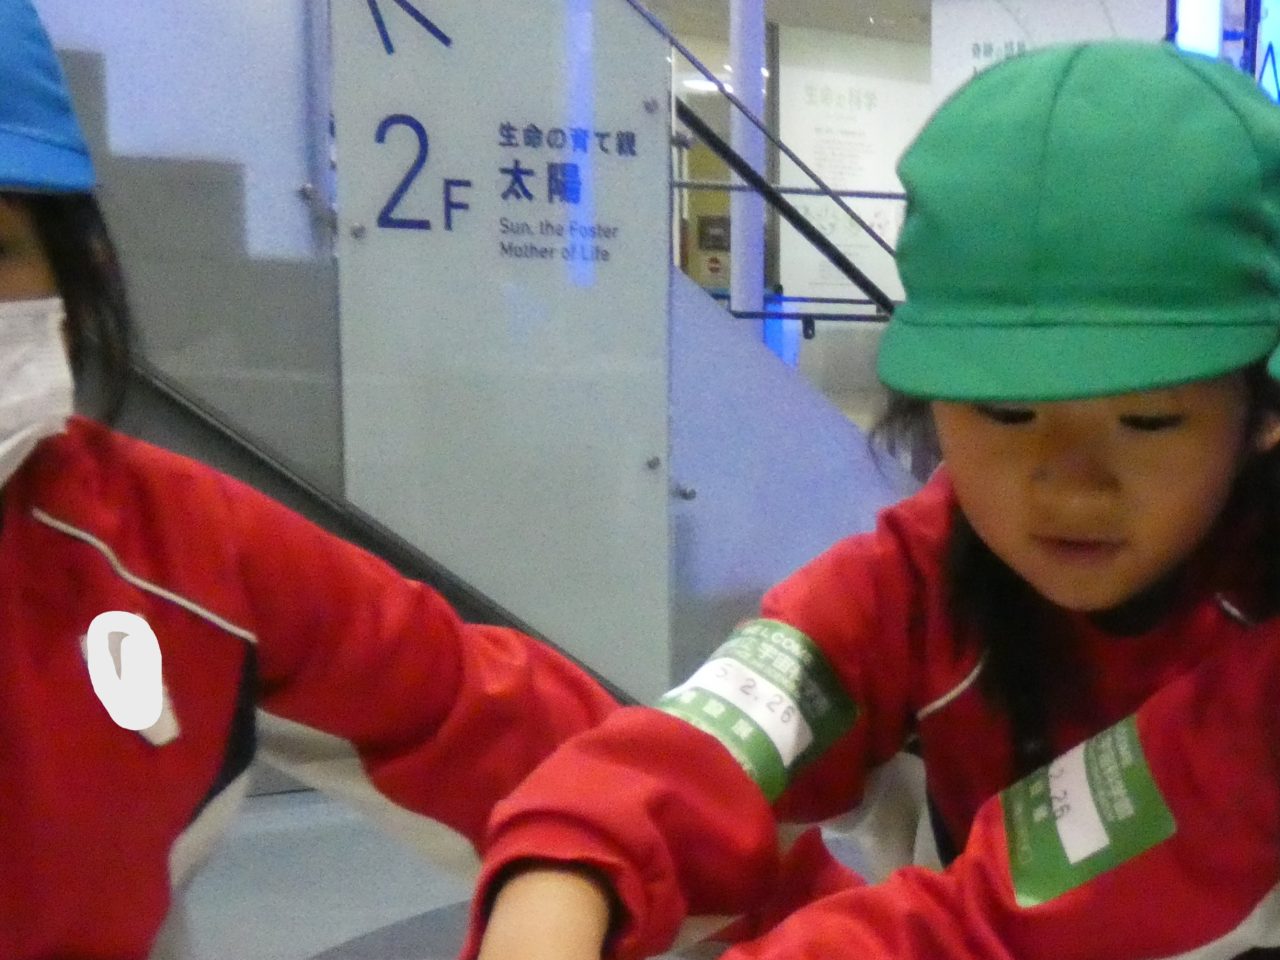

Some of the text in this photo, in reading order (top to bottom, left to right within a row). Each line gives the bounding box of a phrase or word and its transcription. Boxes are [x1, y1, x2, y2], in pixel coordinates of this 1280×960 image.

[499, 121, 637, 157] 生命の育て親
[375, 113, 472, 231] 2F
[499, 159, 582, 204] 太陽
[540, 219, 564, 237] the
[569, 221, 619, 240] Foster
[500, 241, 611, 262] Mother of Life
